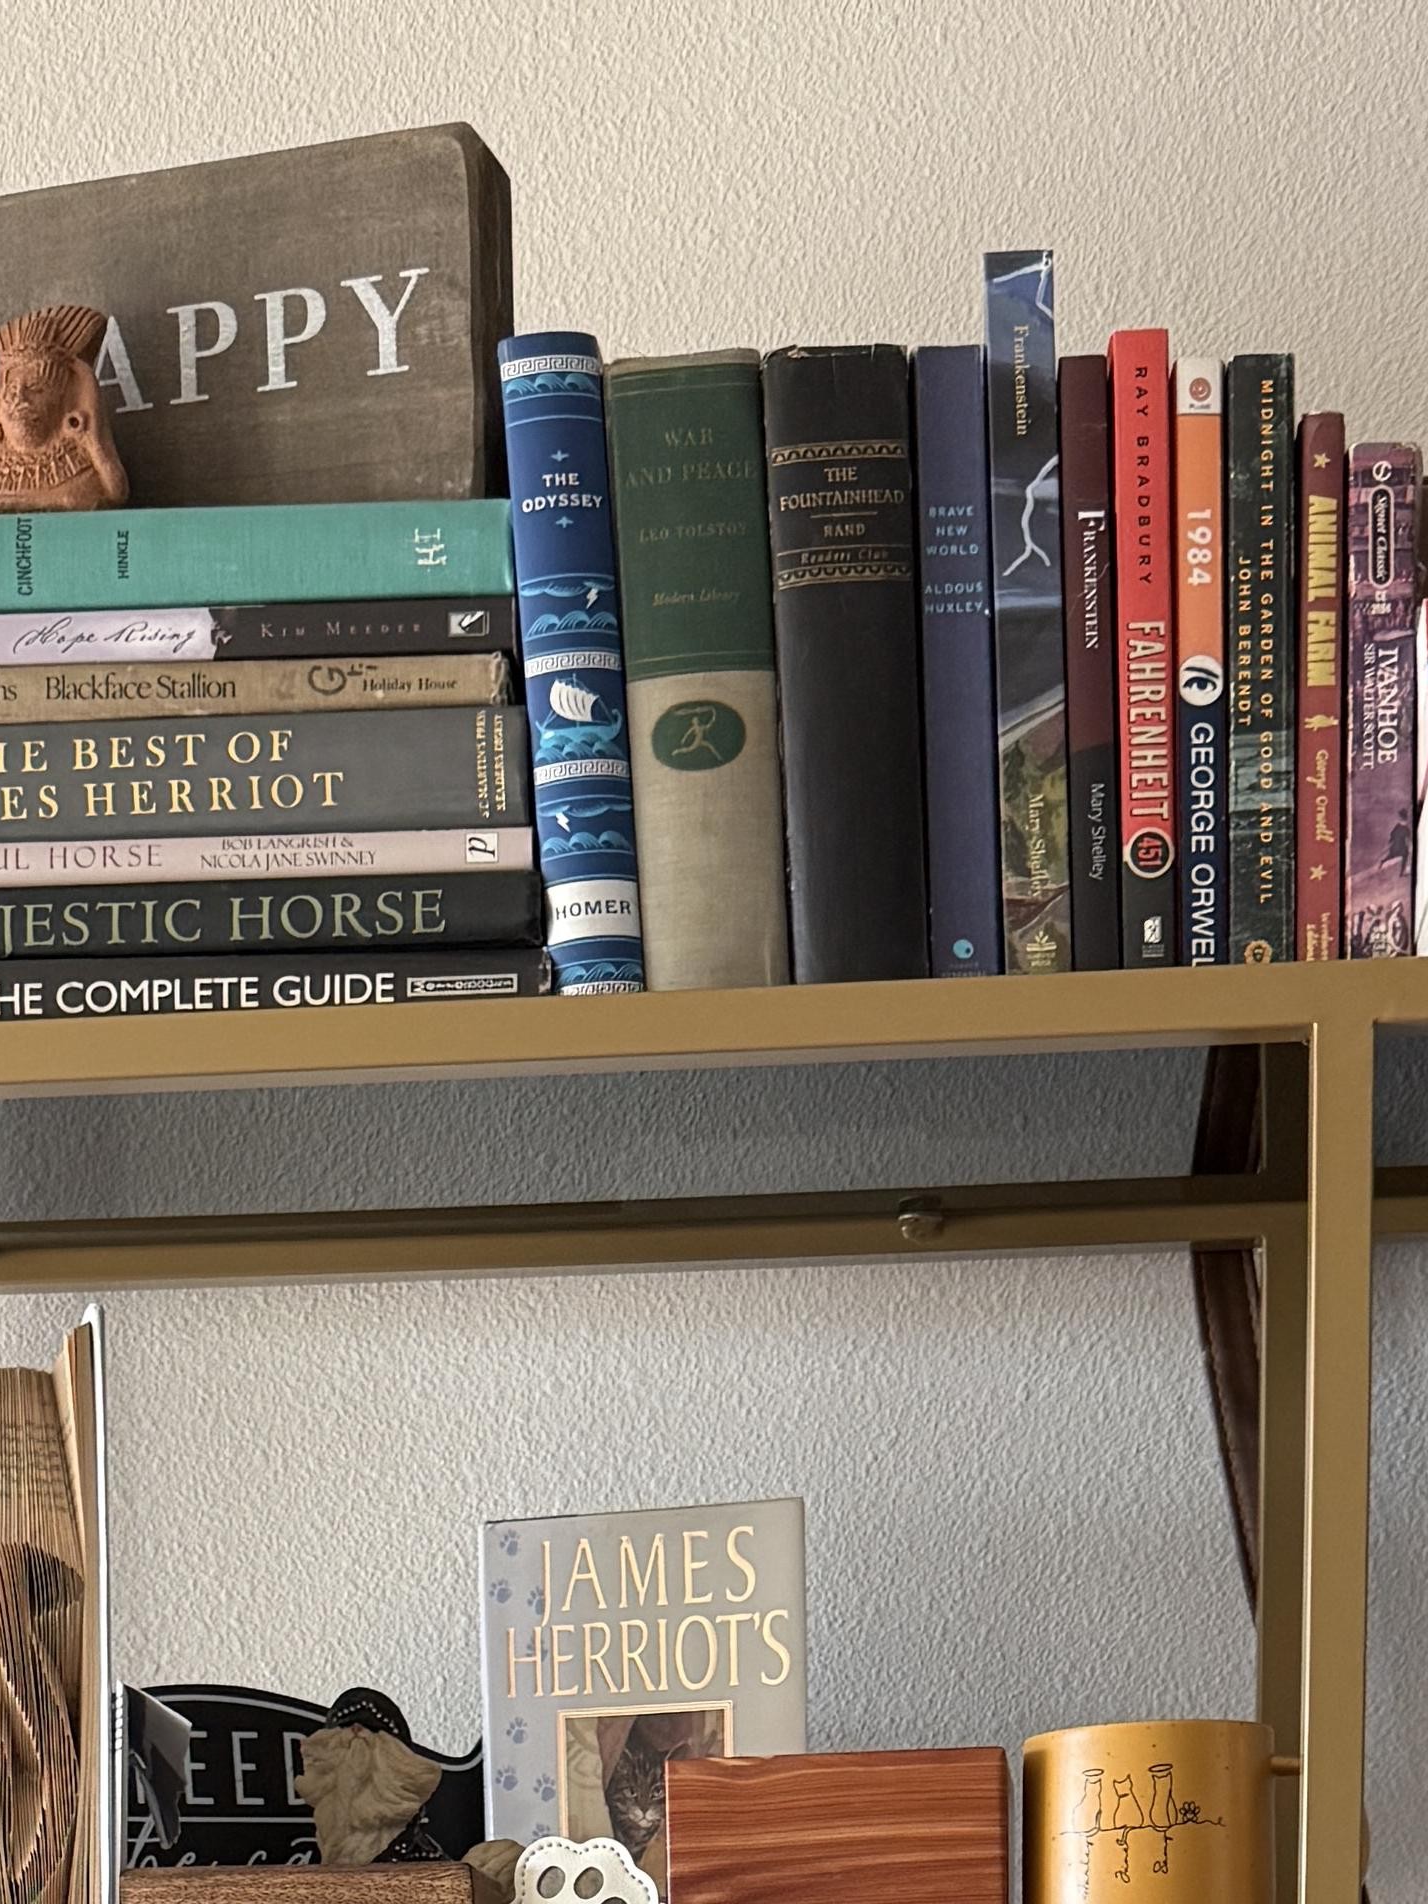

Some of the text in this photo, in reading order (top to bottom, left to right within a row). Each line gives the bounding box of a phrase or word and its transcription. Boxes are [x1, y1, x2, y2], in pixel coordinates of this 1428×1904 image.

[522, 473, 603, 512] THE ODYSSEY
[780, 468, 904, 510] THE FOUNTAINHEAD
[1131, 366, 1152, 585] RAY BRADBURY
[824, 522, 866, 537] RAND
[929, 506, 974, 518] BRAVE
[936, 525, 968, 537] NEW
[17, 516, 34, 597] CINCHFOOT
[117, 529, 130, 580] HINKLE
[926, 542, 978, 556] WORLD
[1186, 510, 1213, 586] 1984
[925, 582, 983, 595] ALDOUS
[1307, 495, 1337, 688] ANIMAL FARM
[45, 673, 153, 702] Blackface
[158, 673, 236, 700] Stallion
[1377, 647, 1399, 764] IVANHOE
[1126, 620, 1170, 820] FAHRENHEIT
[73, 734, 206, 770] BEST
[228, 730, 294, 762] OF
[84, 770, 344, 819] HERRIOT
[1189, 722, 1215, 852] GEORGE
[49, 844, 163, 870] HORSE
[1138, 836, 1163, 868] 451
[230, 889, 445, 940] HORSE
[555, 900, 632, 919] HOMER
[54, 977, 262, 1012] COMPLETE
[272, 971, 395, 1006] GUIDE
[537, 1526, 758, 1628] JAMES
[505, 1611, 793, 1700] HERRIOT'S
